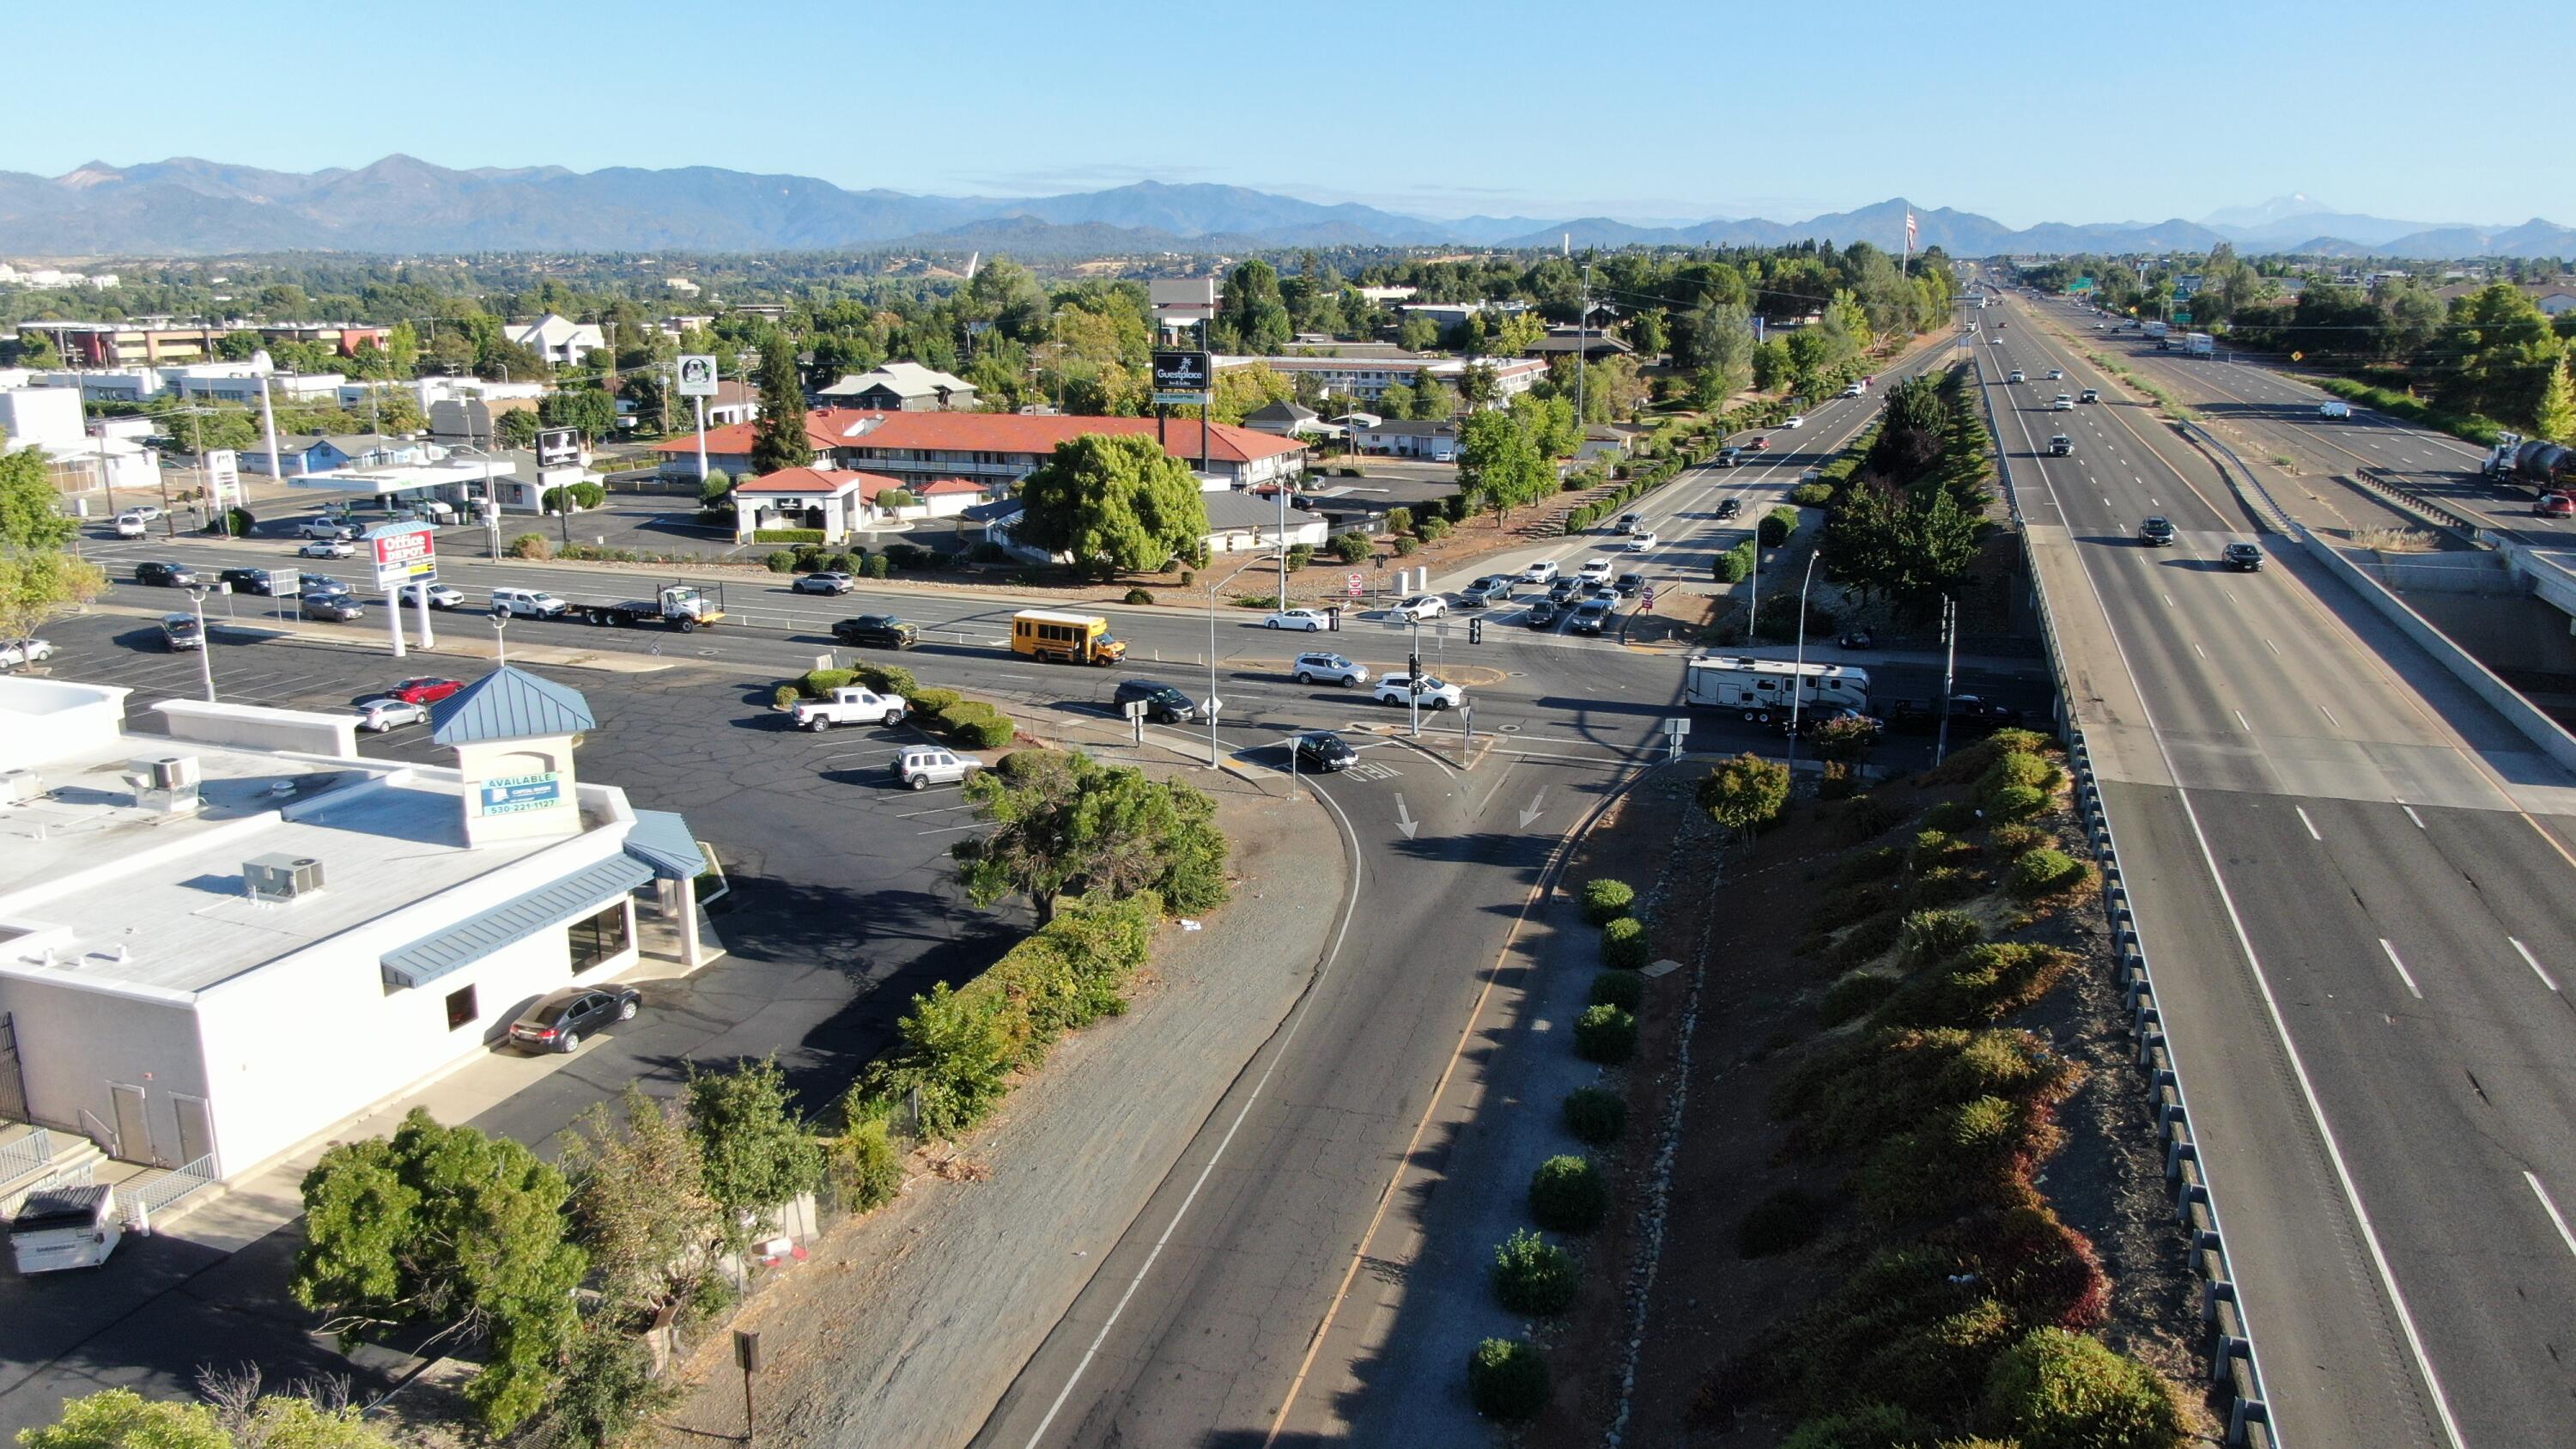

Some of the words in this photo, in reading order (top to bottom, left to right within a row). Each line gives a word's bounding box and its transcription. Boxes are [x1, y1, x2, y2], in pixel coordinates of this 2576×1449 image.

[1157, 368, 1202, 381] Guestplace
[384, 534, 426, 551] Office
[386, 545, 426, 561] DEPOT
[1340, 762, 1404, 782] YIELD
[489, 774, 551, 787] AVAILABLE
